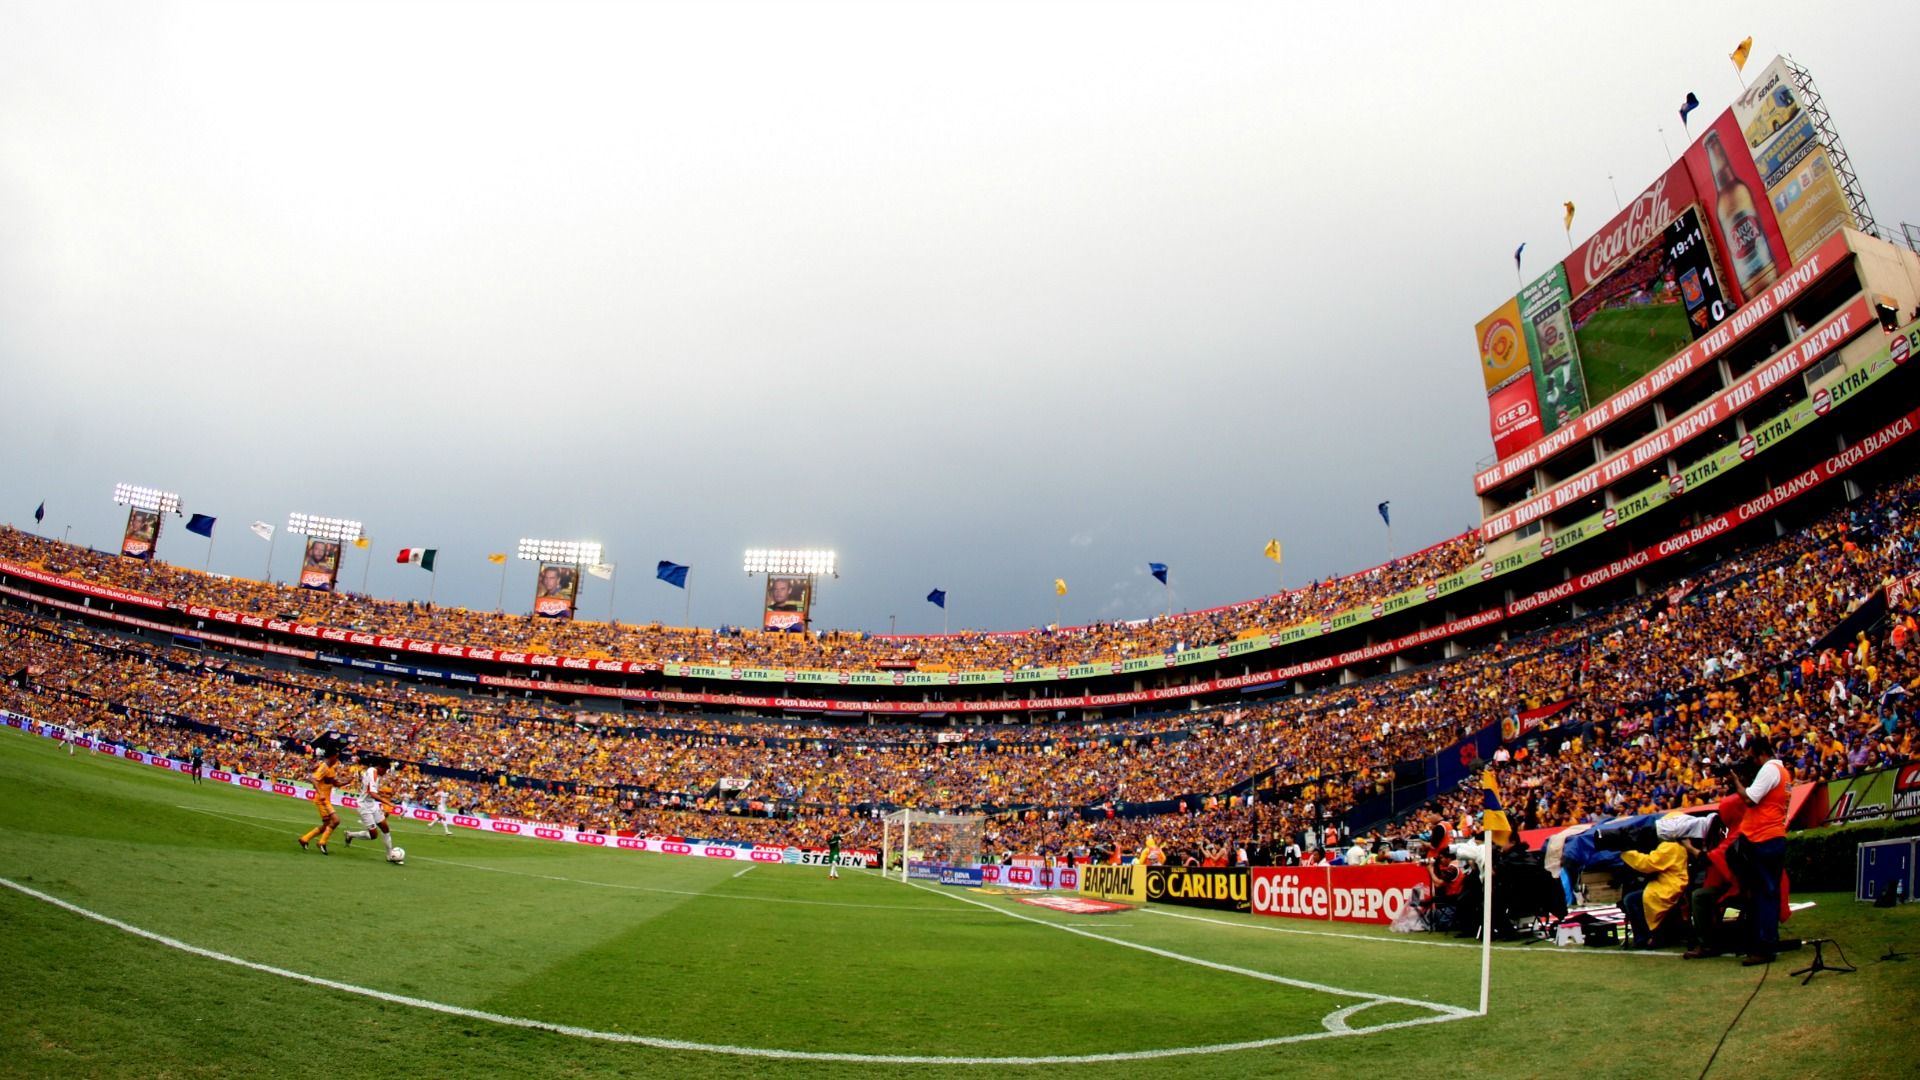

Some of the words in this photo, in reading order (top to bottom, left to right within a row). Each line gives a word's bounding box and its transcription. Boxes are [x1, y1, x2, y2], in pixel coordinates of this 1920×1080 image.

[1758, 74, 1780, 101] SENDA
[1584, 172, 1672, 286] Coca-Cola
[1674, 216, 1685, 232] 1T
[1670, 228, 1702, 259] 19:11
[1702, 267, 1714, 287] 1
[1700, 328, 1731, 356] THE
[1731, 295, 1772, 335] HOME
[1773, 255, 1820, 304] DEPOT
[1711, 300, 1724, 322] 0
[1724, 380, 1755, 411] THE
[1757, 349, 1800, 391] HOME
[1801, 313, 1851, 362] DEPOT
[1583, 408, 1609, 431] THE
[1612, 383, 1649, 415] HOME
[1650, 351, 1693, 391] DEPOT
[1831, 368, 1869, 401] EXTRA
[1756, 417, 1792, 447] EXTRA
[1602, 454, 1631, 481] THE
[1632, 432, 1670, 463] HOME
[1672, 404, 1718, 437] DEPOT
[1826, 446, 1863, 474] CARTA
[1863, 417, 1913, 454] BLANCA
[1477, 469, 1501, 489] THE
[1504, 450, 1537, 475] HOME
[1538, 424, 1578, 458] DEPOT
[1685, 459, 1719, 487] EXTRA
[1485, 515, 1512, 539] THE
[1515, 494, 1552, 525] HOME
[1555, 466, 1601, 505] DEPOT
[1739, 494, 1774, 520] CARTA
[1774, 470, 1820, 502] BLANCA
[1618, 497, 1649, 520] EXTRA
[1554, 527, 1584, 548] EXTRA
[1659, 536, 1690, 556] CARTA
[1691, 518, 1729, 542] BLANCA
[3, 564, 21, 574] BLANCA
[1494, 554, 1523, 572] EXTRA
[1580, 569, 1610, 588] CARTA
[1610, 551, 1649, 575] BLANCA
[21, 569, 37, 578] CARTA
[37, 572, 55, 583] BLANCA
[55, 577, 71, 586] CARTA
[71, 581, 90, 592] BLANCA
[90, 585, 106, 595] CARTA
[106, 589, 126, 600] BLANCA
[1439, 576, 1464, 593] EXTRA
[126, 593, 143, 603] CARTA
[143, 597, 163, 608] BLANCA
[1383, 597, 1409, 612] EXTRA
[1509, 598, 1537, 615] CARTA
[1537, 582, 1574, 602] BLANCA
[1332, 614, 1357, 629] EXTRA
[1448, 620, 1472, 633] CARTA
[1472, 609, 1501, 626] BLANCA
[1282, 628, 1306, 642] EXTRA
[1398, 633, 1419, 648] CARTA
[1419, 624, 1448, 640] BLANCA
[1230, 641, 1254, 654] EXTRA
[1339, 652, 1363, 664] CARTA
[1364, 642, 1394, 659] BLANCA
[319, 654, 344, 664] Banamex
[351, 659, 376, 669] Banamex
[1124, 660, 1148, 671] EXTRA
[1177, 652, 1201, 663] EXTRA
[383, 664, 409, 673] Banamex
[417, 669, 442, 678] Banamex
[692, 668, 715, 677] EXTRA
[744, 671, 768, 679] EXTRA
[1016, 671, 1041, 680] EXTRA
[1070, 667, 1095, 677] EXTRA
[1278, 666, 1301, 678] CARTA
[1302, 658, 1333, 672] BLANCA
[451, 673, 477, 682] Banamex
[797, 673, 822, 681] EXTRA
[851, 675, 876, 683] EXTRA
[906, 675, 931, 683] EXTRA
[961, 674, 986, 682] EXTRA
[1217, 677, 1242, 690] CARTA
[1243, 671, 1273, 684] BLANCA
[652, 691, 674, 700] CARTA
[675, 692, 705, 702] BLANCA
[1091, 695, 1116, 704] CARTA
[1116, 692, 1147, 702] BLANCA
[1153, 687, 1179, 699] CARTA
[1179, 682, 1210, 694] BLANCA
[712, 695, 736, 704] CARTA
[736, 695, 767, 706] BLANCA
[775, 698, 799, 707] CARTA
[799, 698, 828, 708] BLANCA
[836, 701, 861, 710] CARTA
[862, 700, 893, 710] BLANCA
[901, 701, 925, 711] CARTA
[926, 701, 957, 710] BLANCA
[963, 701, 989, 711] CARTA
[989, 699, 1021, 709] BLANCA
[1028, 699, 1052, 709] CARTA
[1052, 696, 1084, 706] BLANCA
[1084, 865, 1134, 897] BARDAHL
[1167, 873, 1247, 901] CARIBU
[1253, 875, 1328, 915] Office
